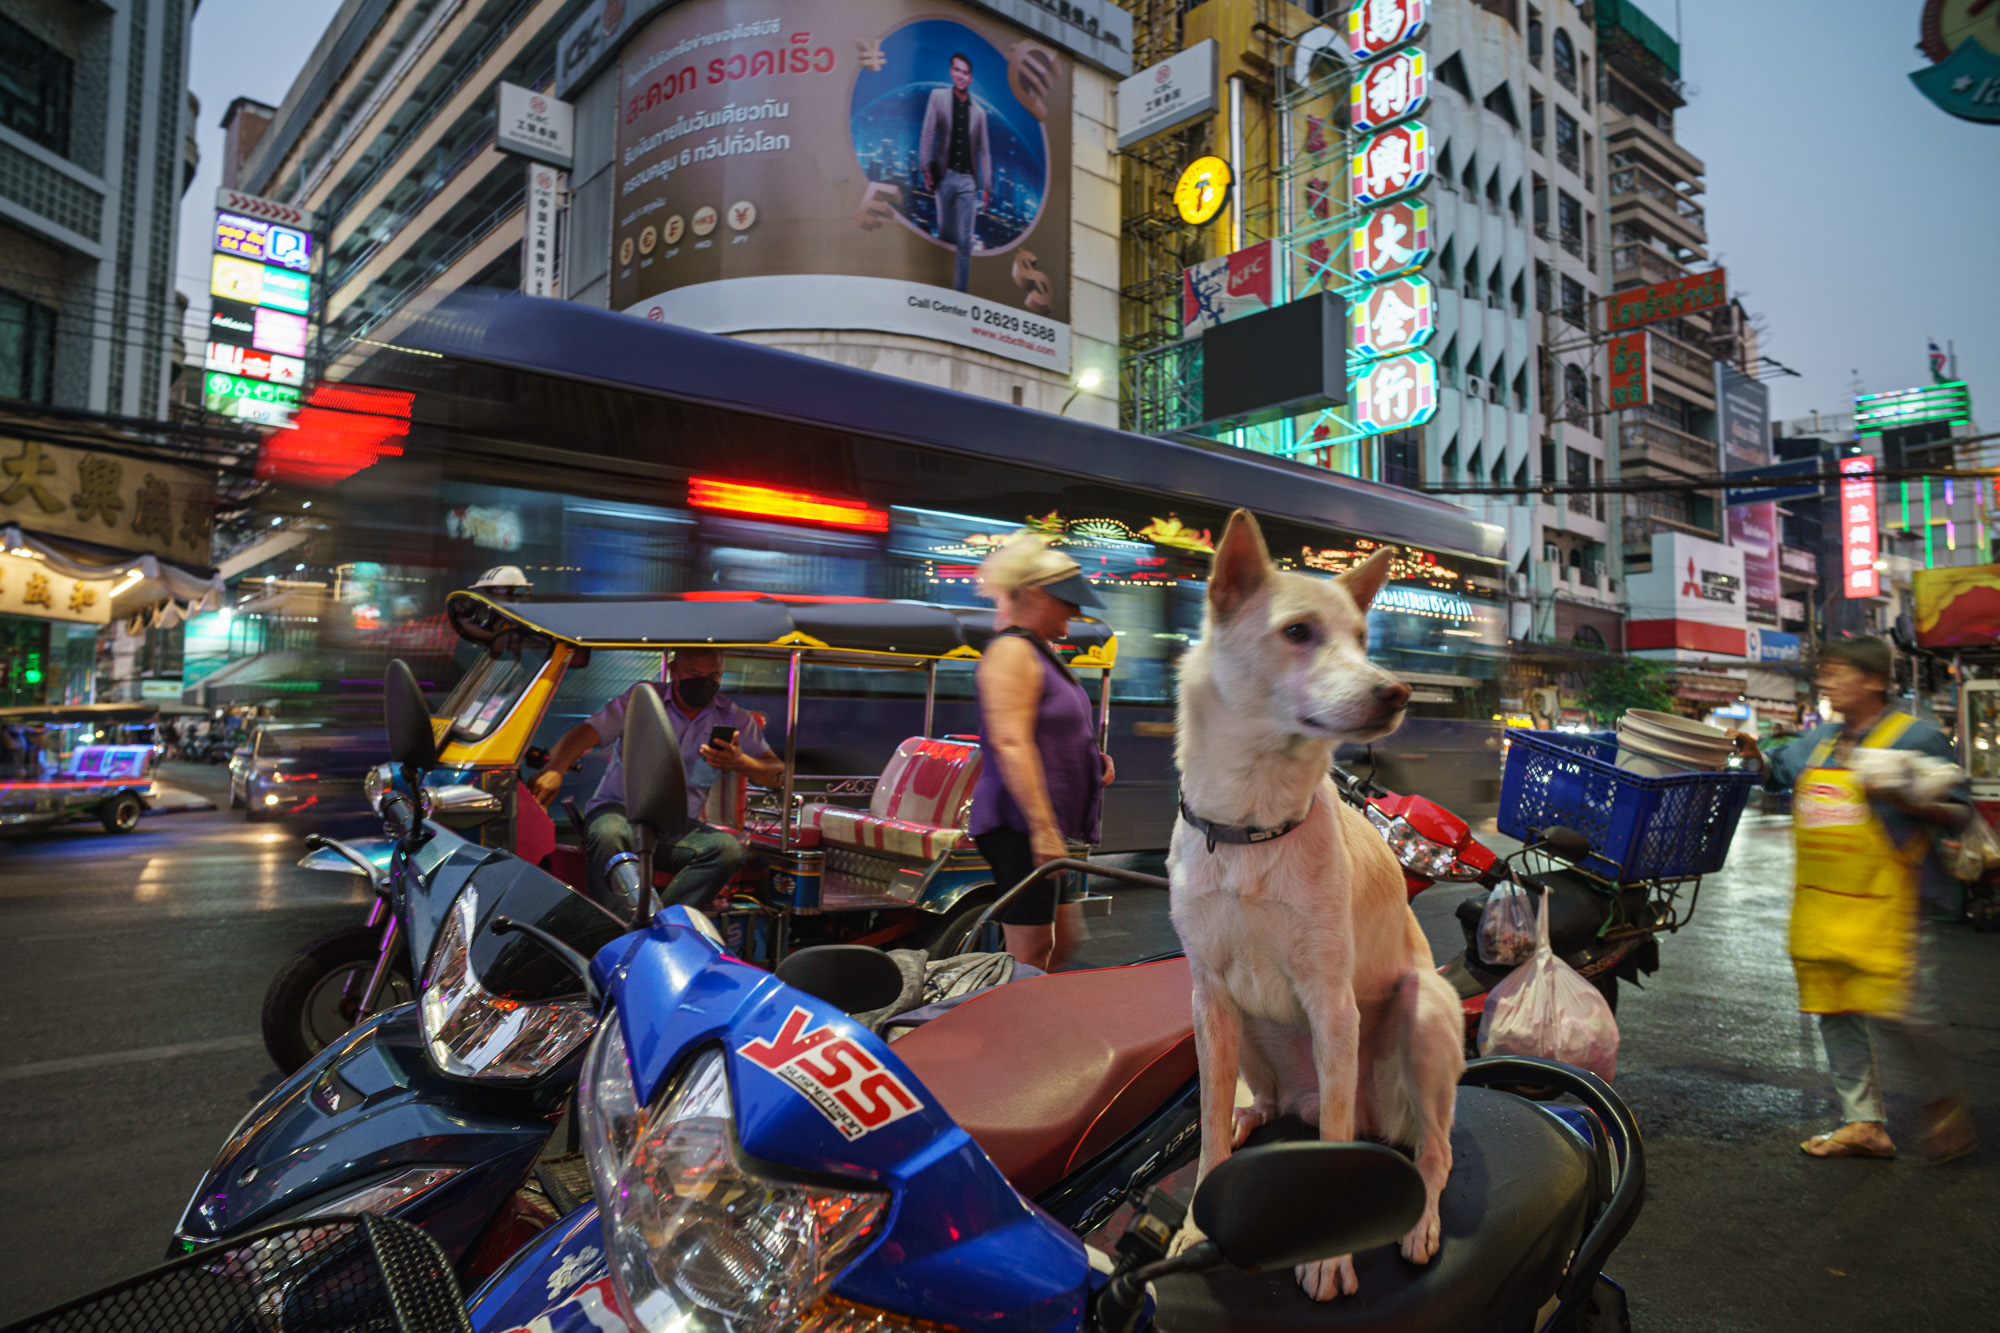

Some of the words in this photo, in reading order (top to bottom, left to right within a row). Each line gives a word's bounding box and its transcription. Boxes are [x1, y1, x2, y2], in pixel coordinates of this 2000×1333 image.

[626, 65, 697, 125] สะดวก
[707, 31, 835, 85] รวดเร็ว
[621, 155, 679, 197] ครอบคลุม
[680, 148, 692, 167] 6
[693, 127, 791, 163] ทวีปทั่วโลก
[274, 233, 298, 256] P
[1231, 256, 1265, 290] KFC
[907, 295, 931, 309] Call
[932, 300, 968, 318] Center
[971, 306, 981, 321] 0
[984, 309, 1019, 332] 2629
[1022, 320, 1056, 343] 5588
[1609, 273, 1725, 326] โรงรับจำนำ
[971, 326, 1056, 357] www.icbcthai.com
[741, 1010, 918, 1128] YSS
[1163, 1117, 1199, 1159] 125
